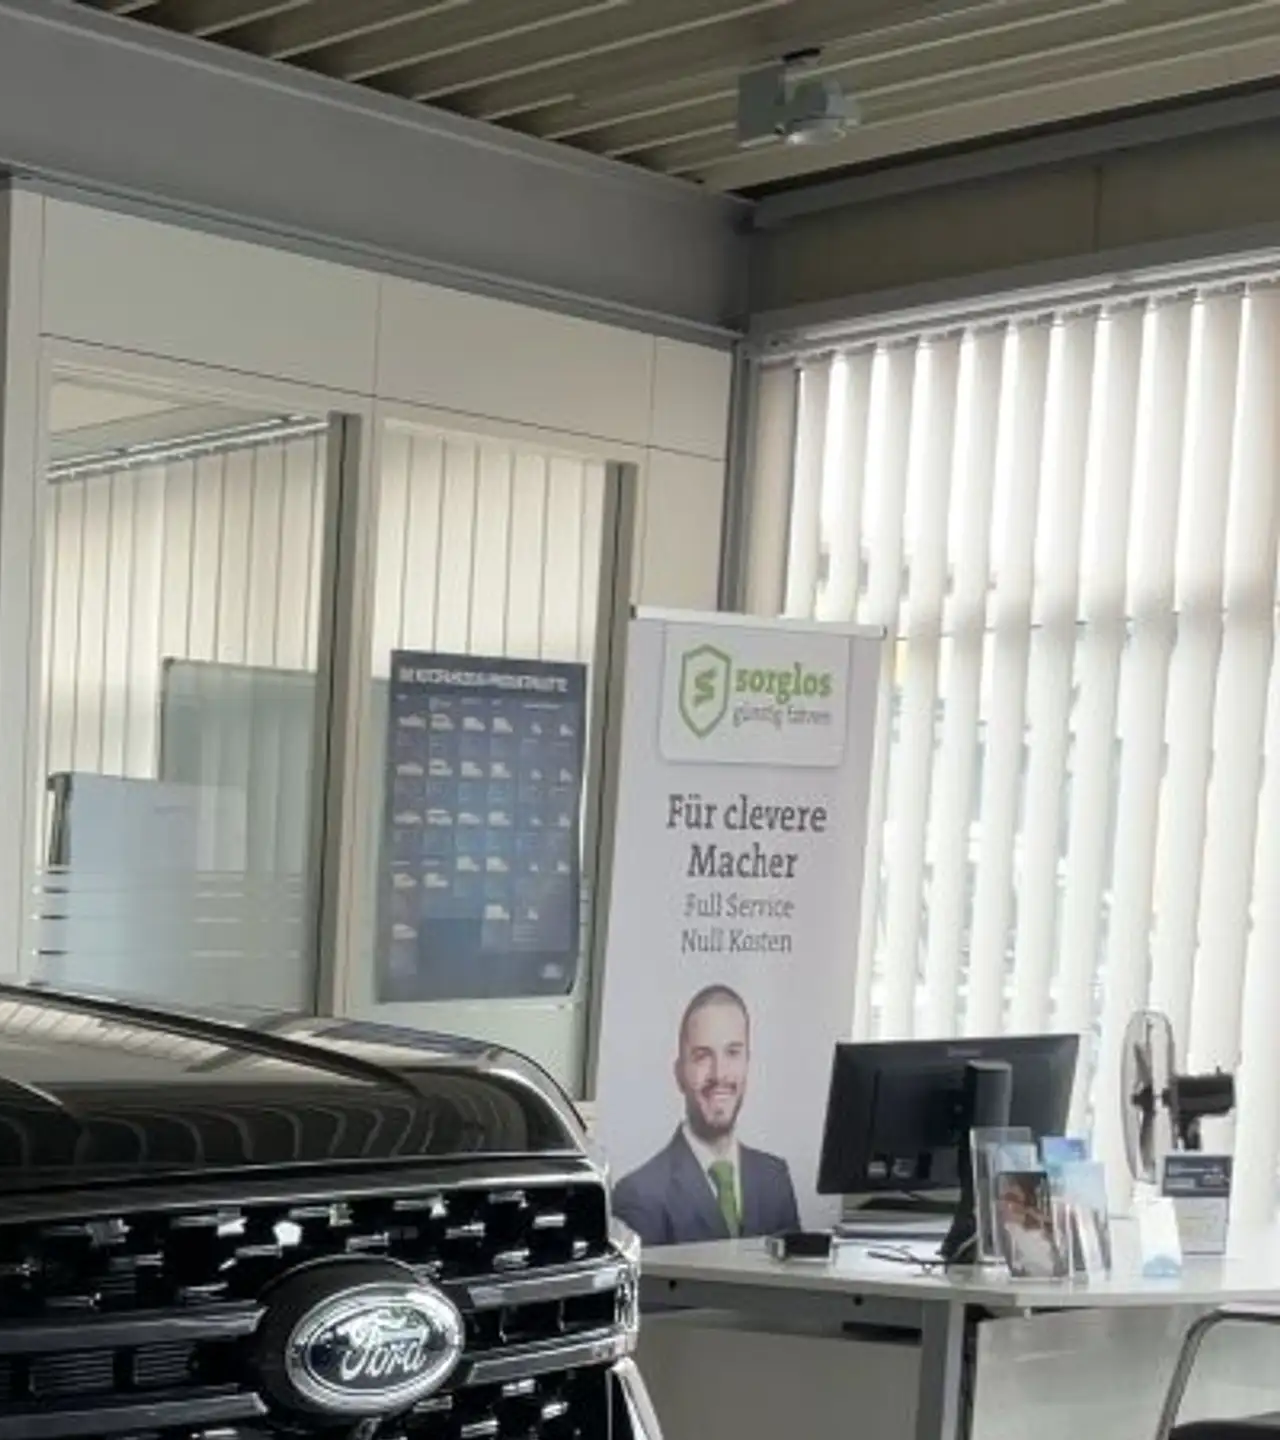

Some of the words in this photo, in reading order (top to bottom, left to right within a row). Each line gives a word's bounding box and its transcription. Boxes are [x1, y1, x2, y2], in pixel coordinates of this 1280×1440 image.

[736, 660, 833, 704] sorglos
[666, 793, 718, 830] Für
[723, 794, 828, 832] clevere
[686, 842, 799, 879] Macher
[683, 892, 721, 917] Full
[726, 893, 795, 919] Service
[681, 929, 724, 954] Null
[728, 929, 793, 954] Kosten
